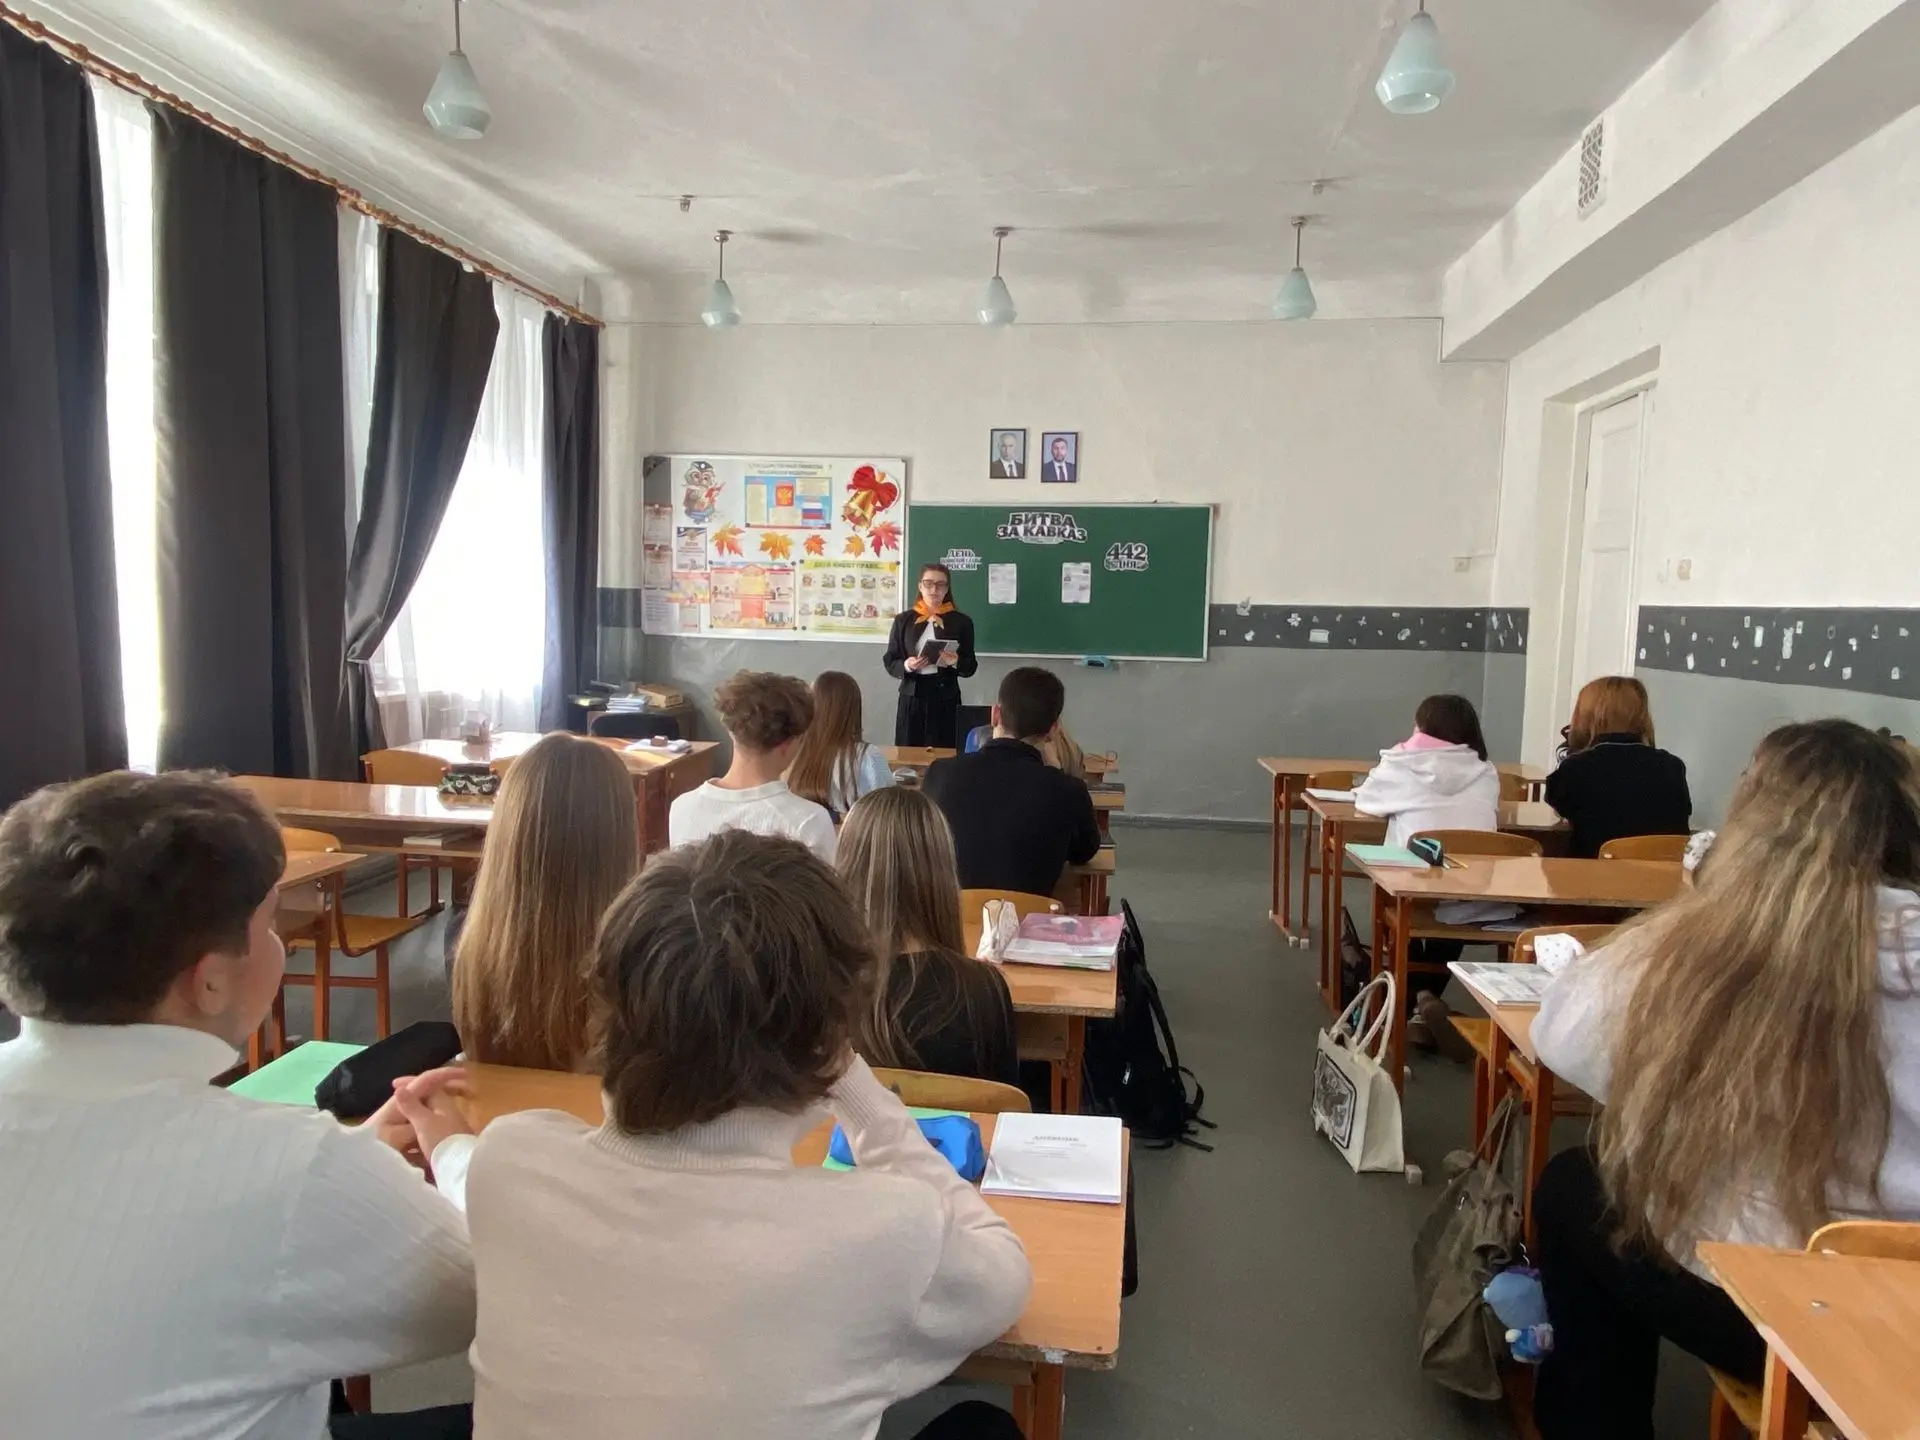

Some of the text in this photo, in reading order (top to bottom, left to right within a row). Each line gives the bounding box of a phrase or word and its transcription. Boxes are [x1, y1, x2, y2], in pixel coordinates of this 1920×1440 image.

[1010, 513, 1076, 528] БИТВА
[998, 525, 1086, 541] ЗА КАВКАЗ
[948, 549, 975, 558] ДЕНЬ
[1107, 543, 1147, 561] 442
